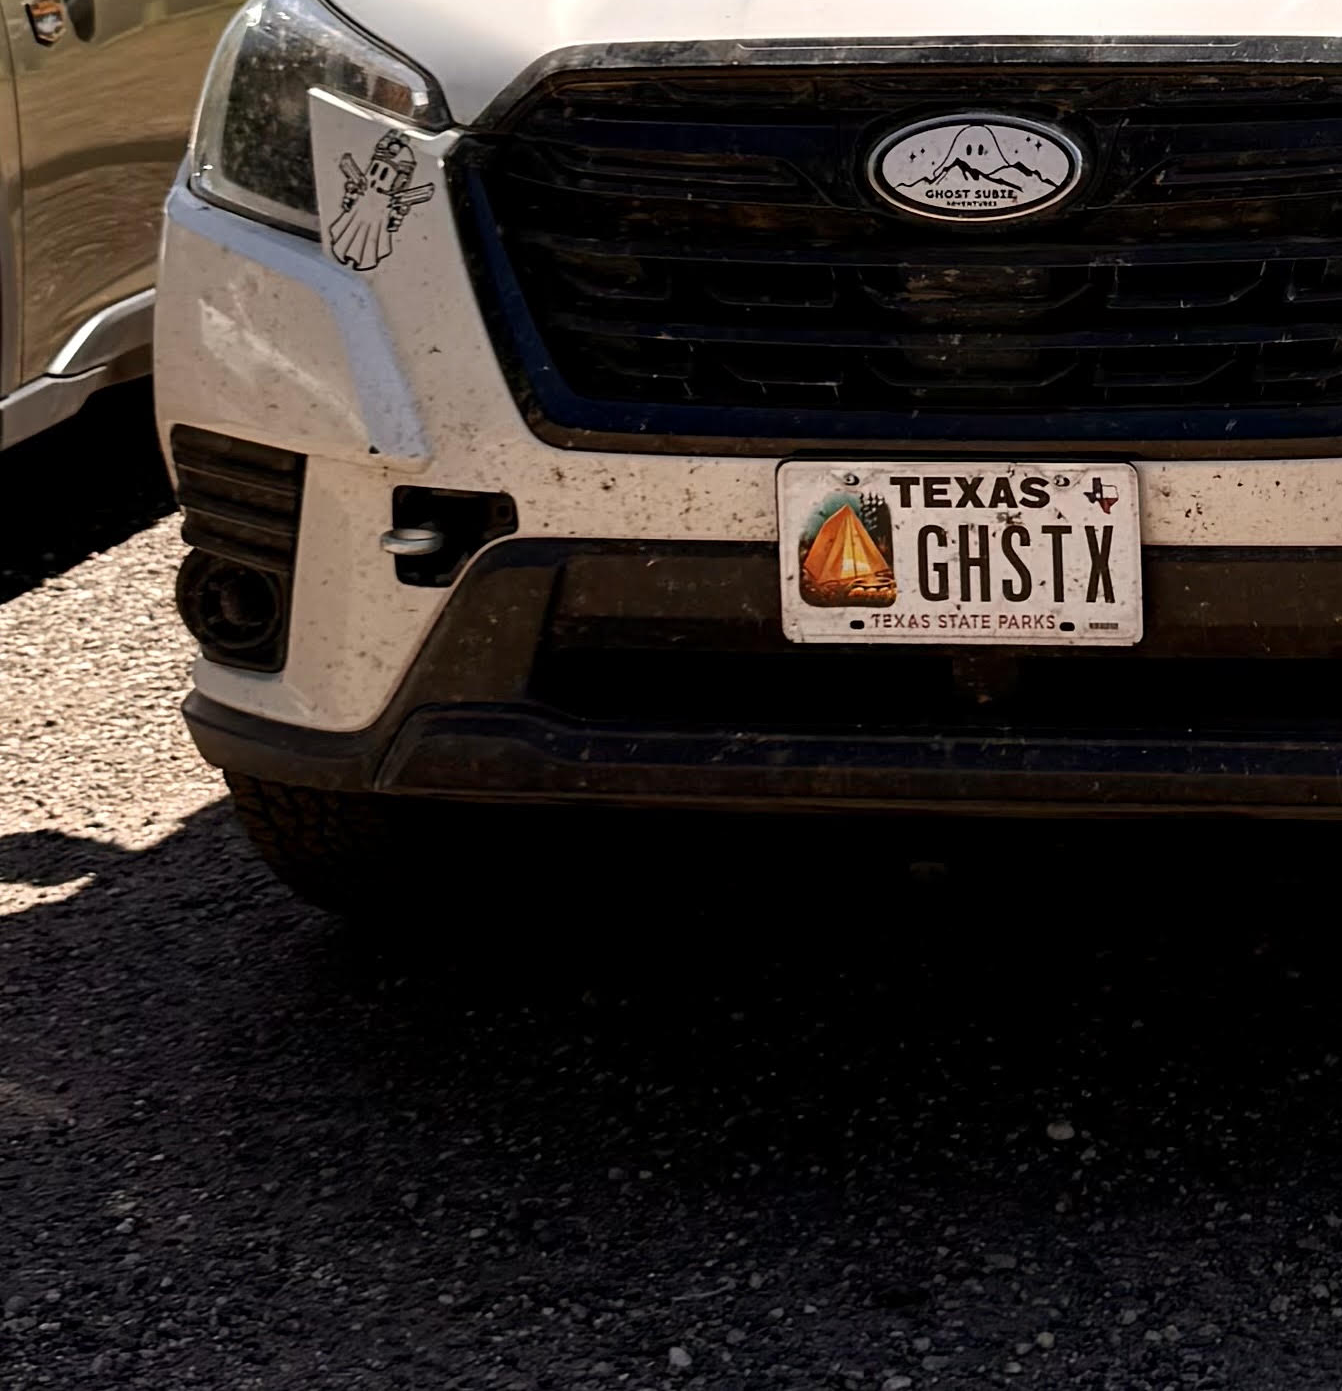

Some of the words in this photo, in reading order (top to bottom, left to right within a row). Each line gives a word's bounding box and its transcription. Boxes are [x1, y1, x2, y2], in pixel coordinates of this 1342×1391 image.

[925, 190, 971, 199] GHOST
[889, 476, 1051, 509] TEXAS
[917, 525, 1116, 604] GHSTX
[871, 614, 931, 630] TEXAS
[937, 615, 992, 630] STATE
[998, 614, 1056, 630] PARKS
